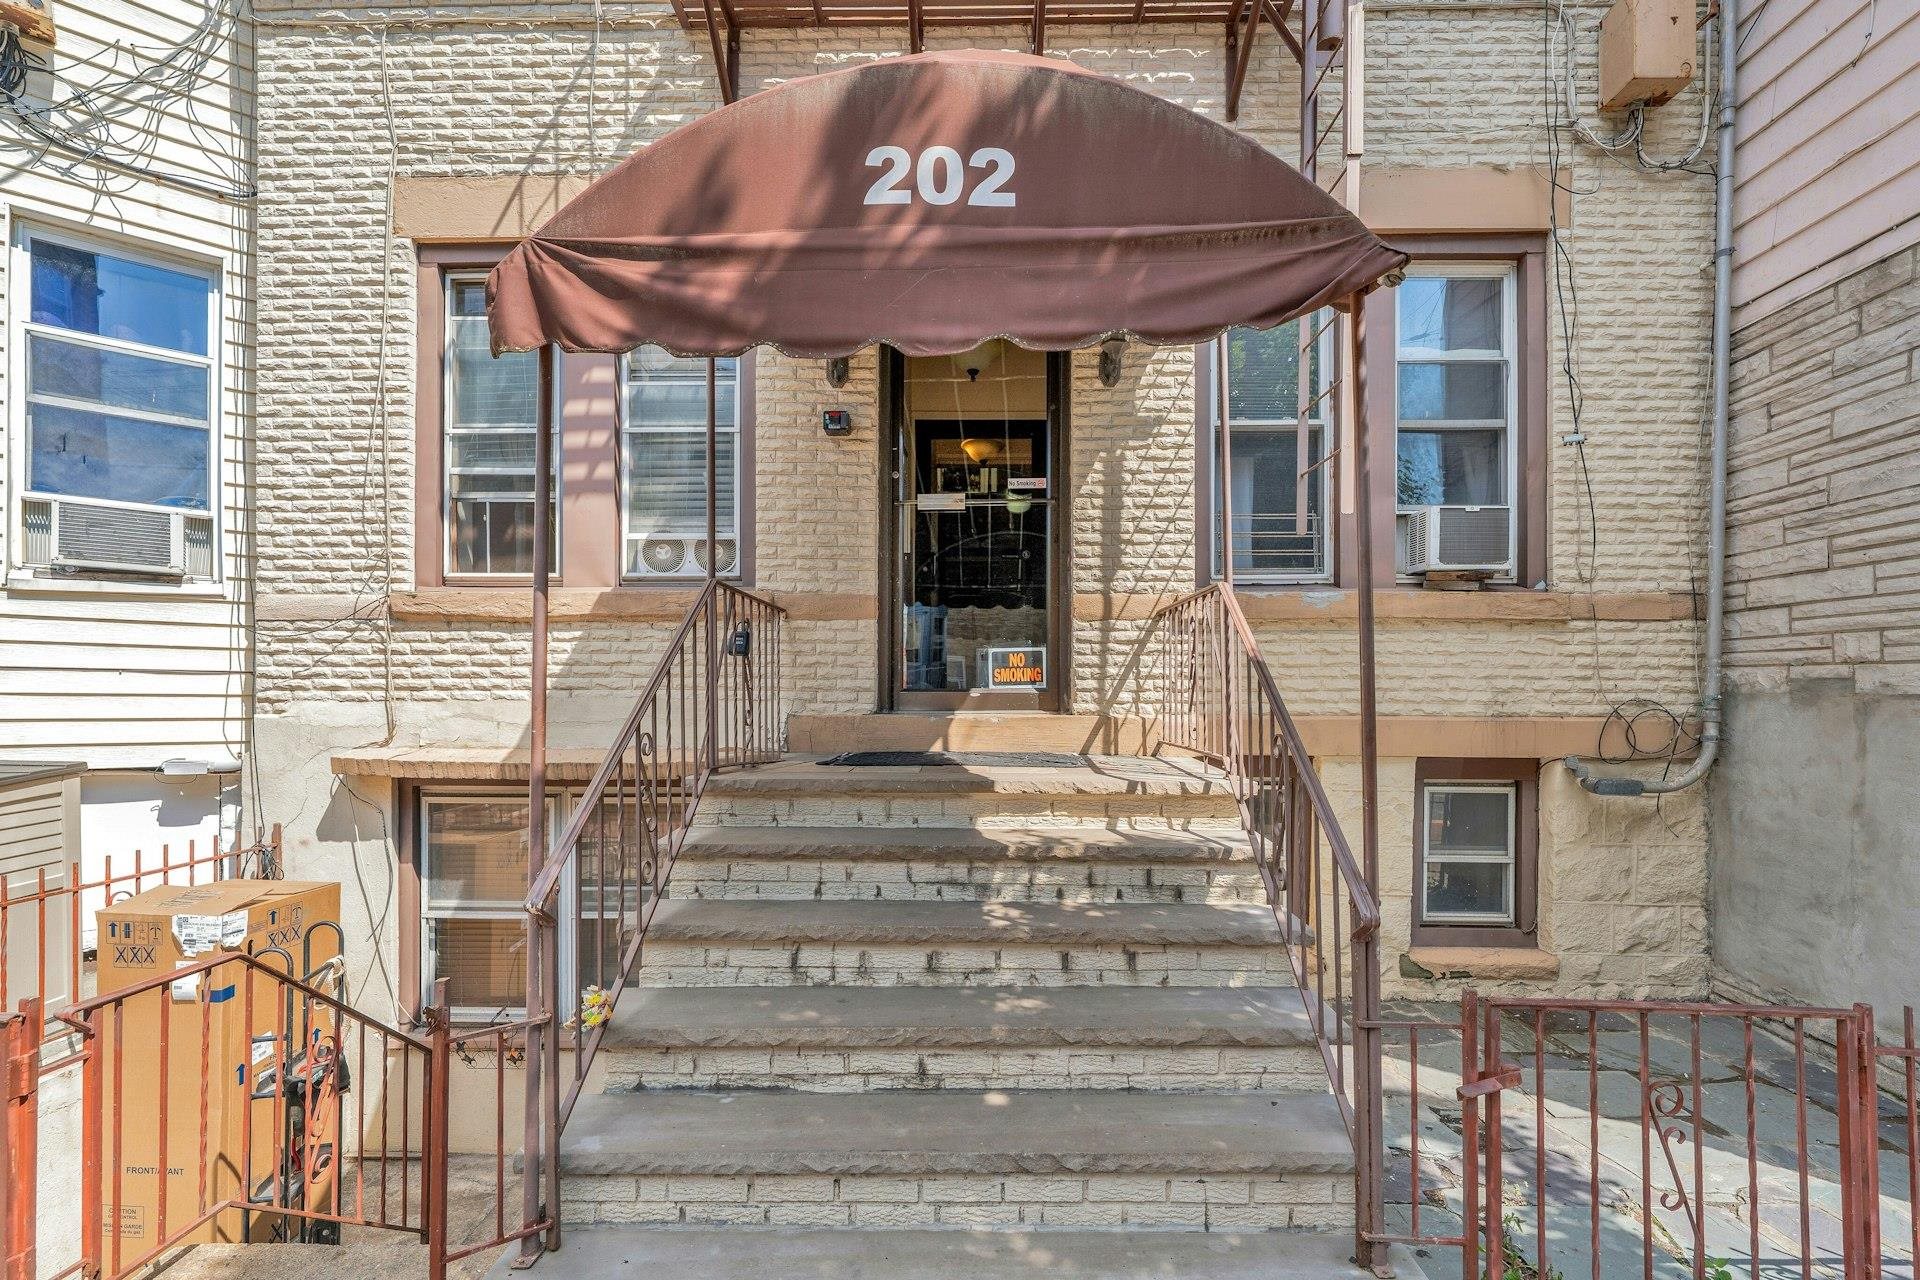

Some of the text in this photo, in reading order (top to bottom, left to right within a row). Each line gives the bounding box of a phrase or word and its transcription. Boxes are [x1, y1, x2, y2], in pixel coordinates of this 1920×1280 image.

[863, 145, 1016, 207] 202
[1016, 480, 1037, 488] Smoking
[1008, 652, 1026, 667] NO
[993, 667, 1042, 683] SMOKING
[126, 1166, 184, 1175] FRONT/ANT
